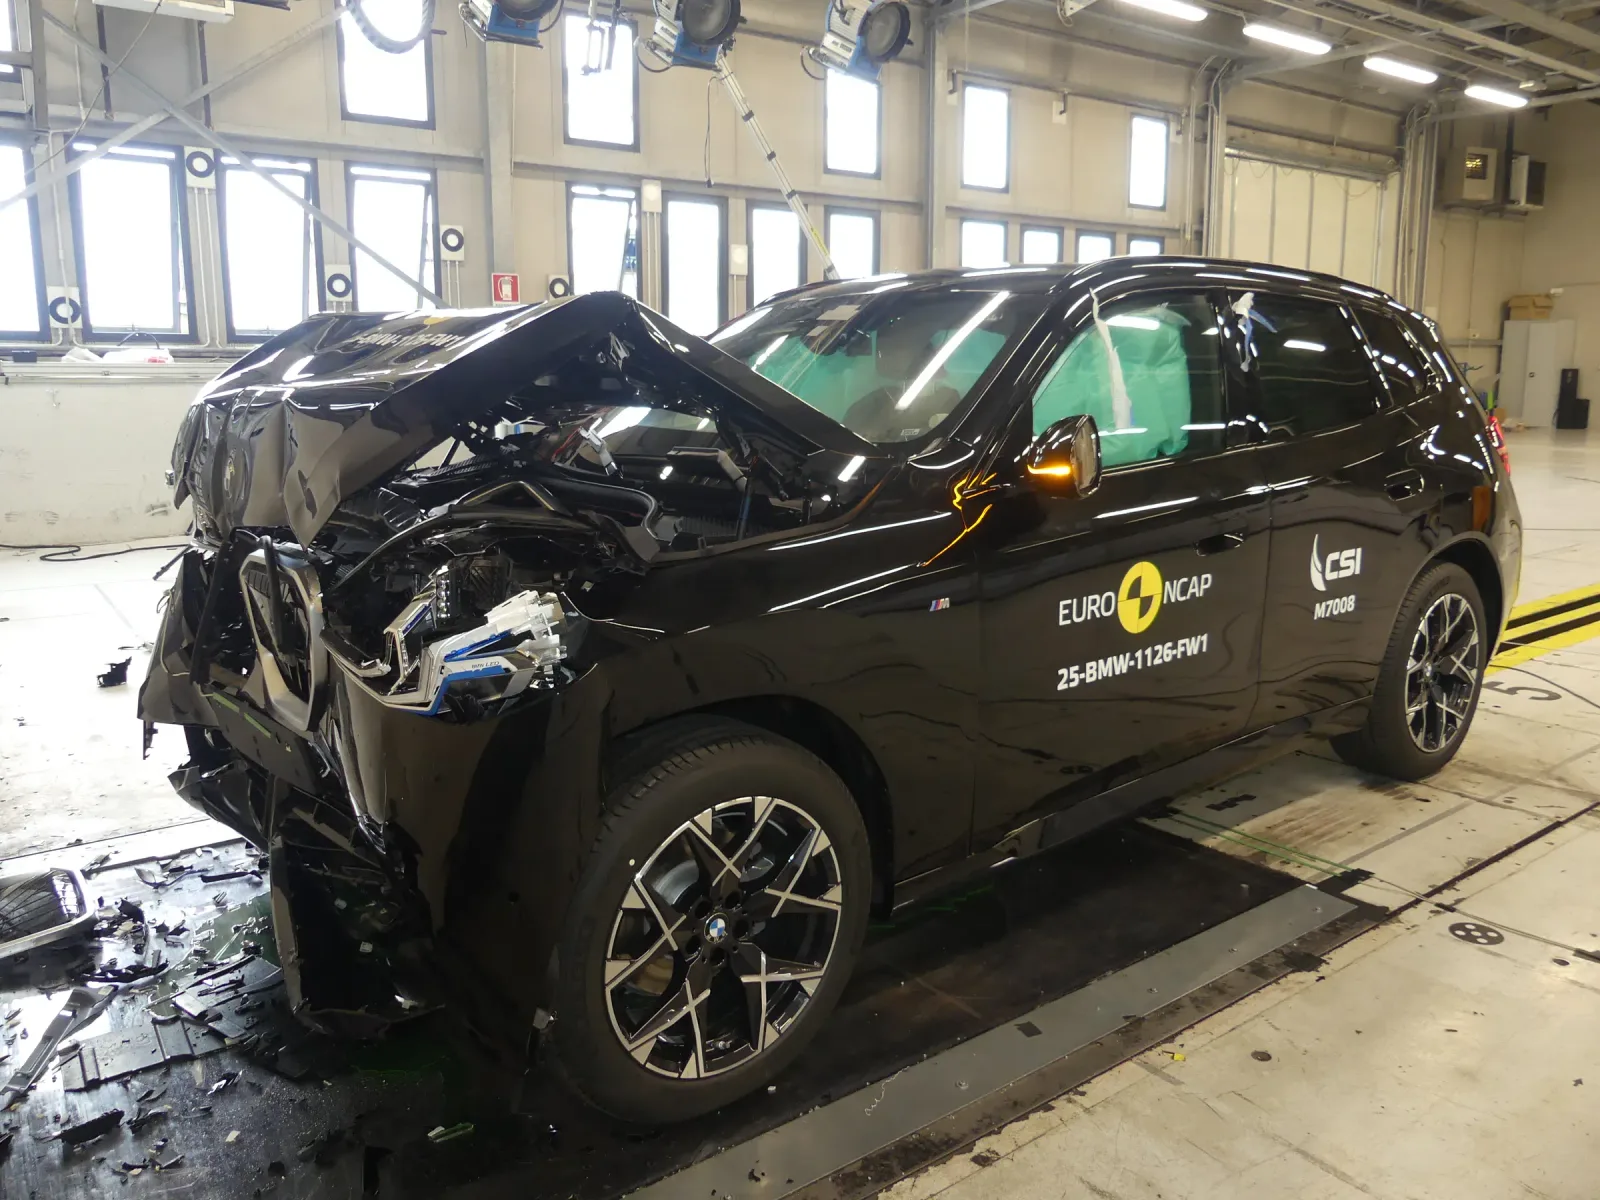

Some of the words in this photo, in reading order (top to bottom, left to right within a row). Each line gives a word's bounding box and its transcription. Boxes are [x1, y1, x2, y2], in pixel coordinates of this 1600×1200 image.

[1325, 547, 1362, 581] CSI
[1058, 591, 1116, 626] EURO
[1163, 573, 1213, 604] NCAP
[1313, 594, 1356, 620] M7008
[1056, 633, 1209, 691] 25-BMW-1126-FW1
